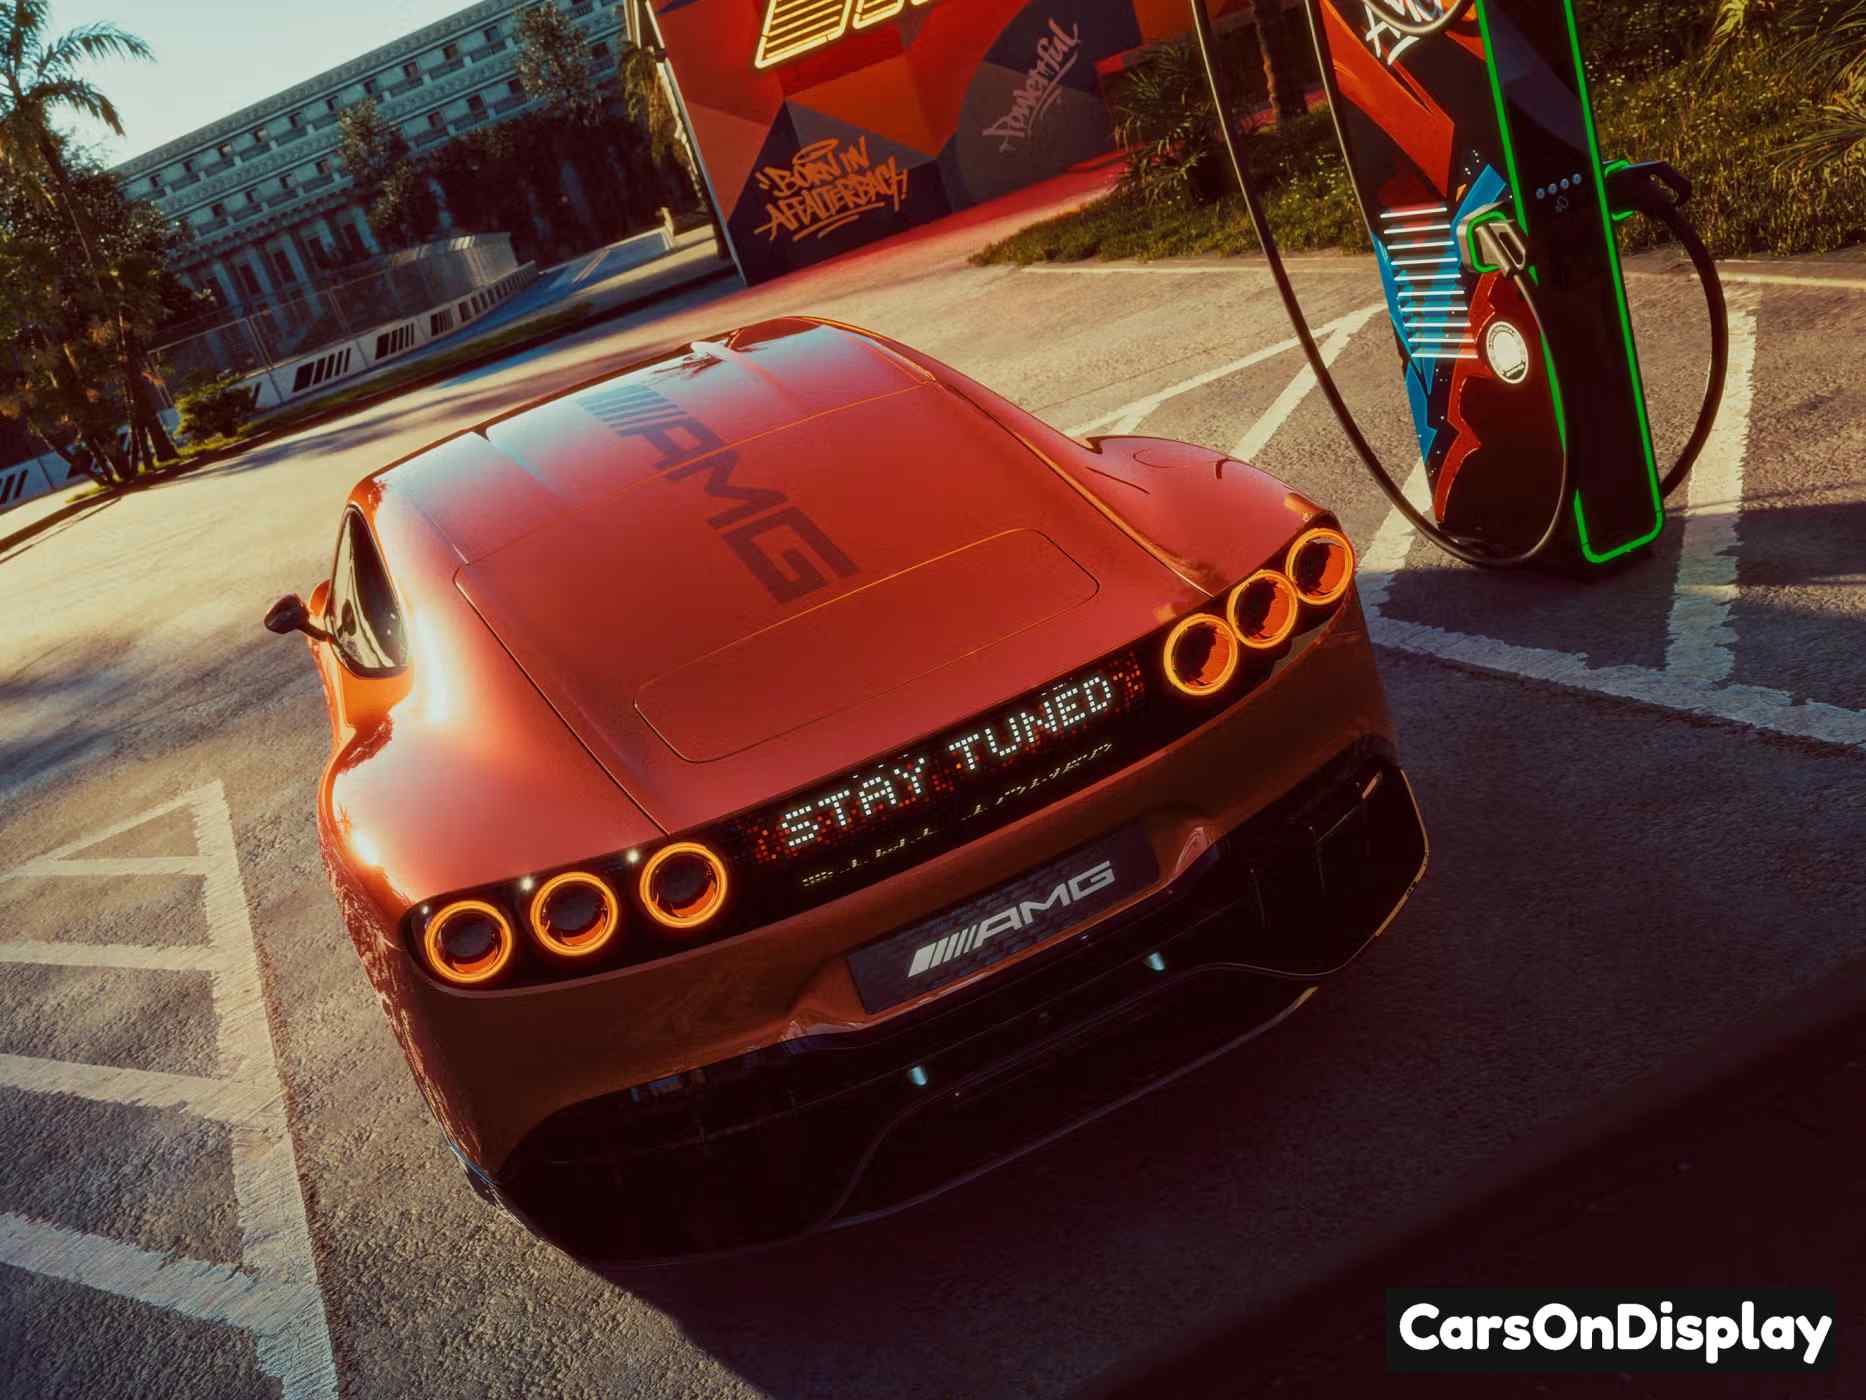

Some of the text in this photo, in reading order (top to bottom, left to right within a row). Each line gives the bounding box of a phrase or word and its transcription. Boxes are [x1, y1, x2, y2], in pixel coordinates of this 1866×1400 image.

[839, 136, 869, 172] IN
[781, 676, 1113, 848] STAY TUNED
